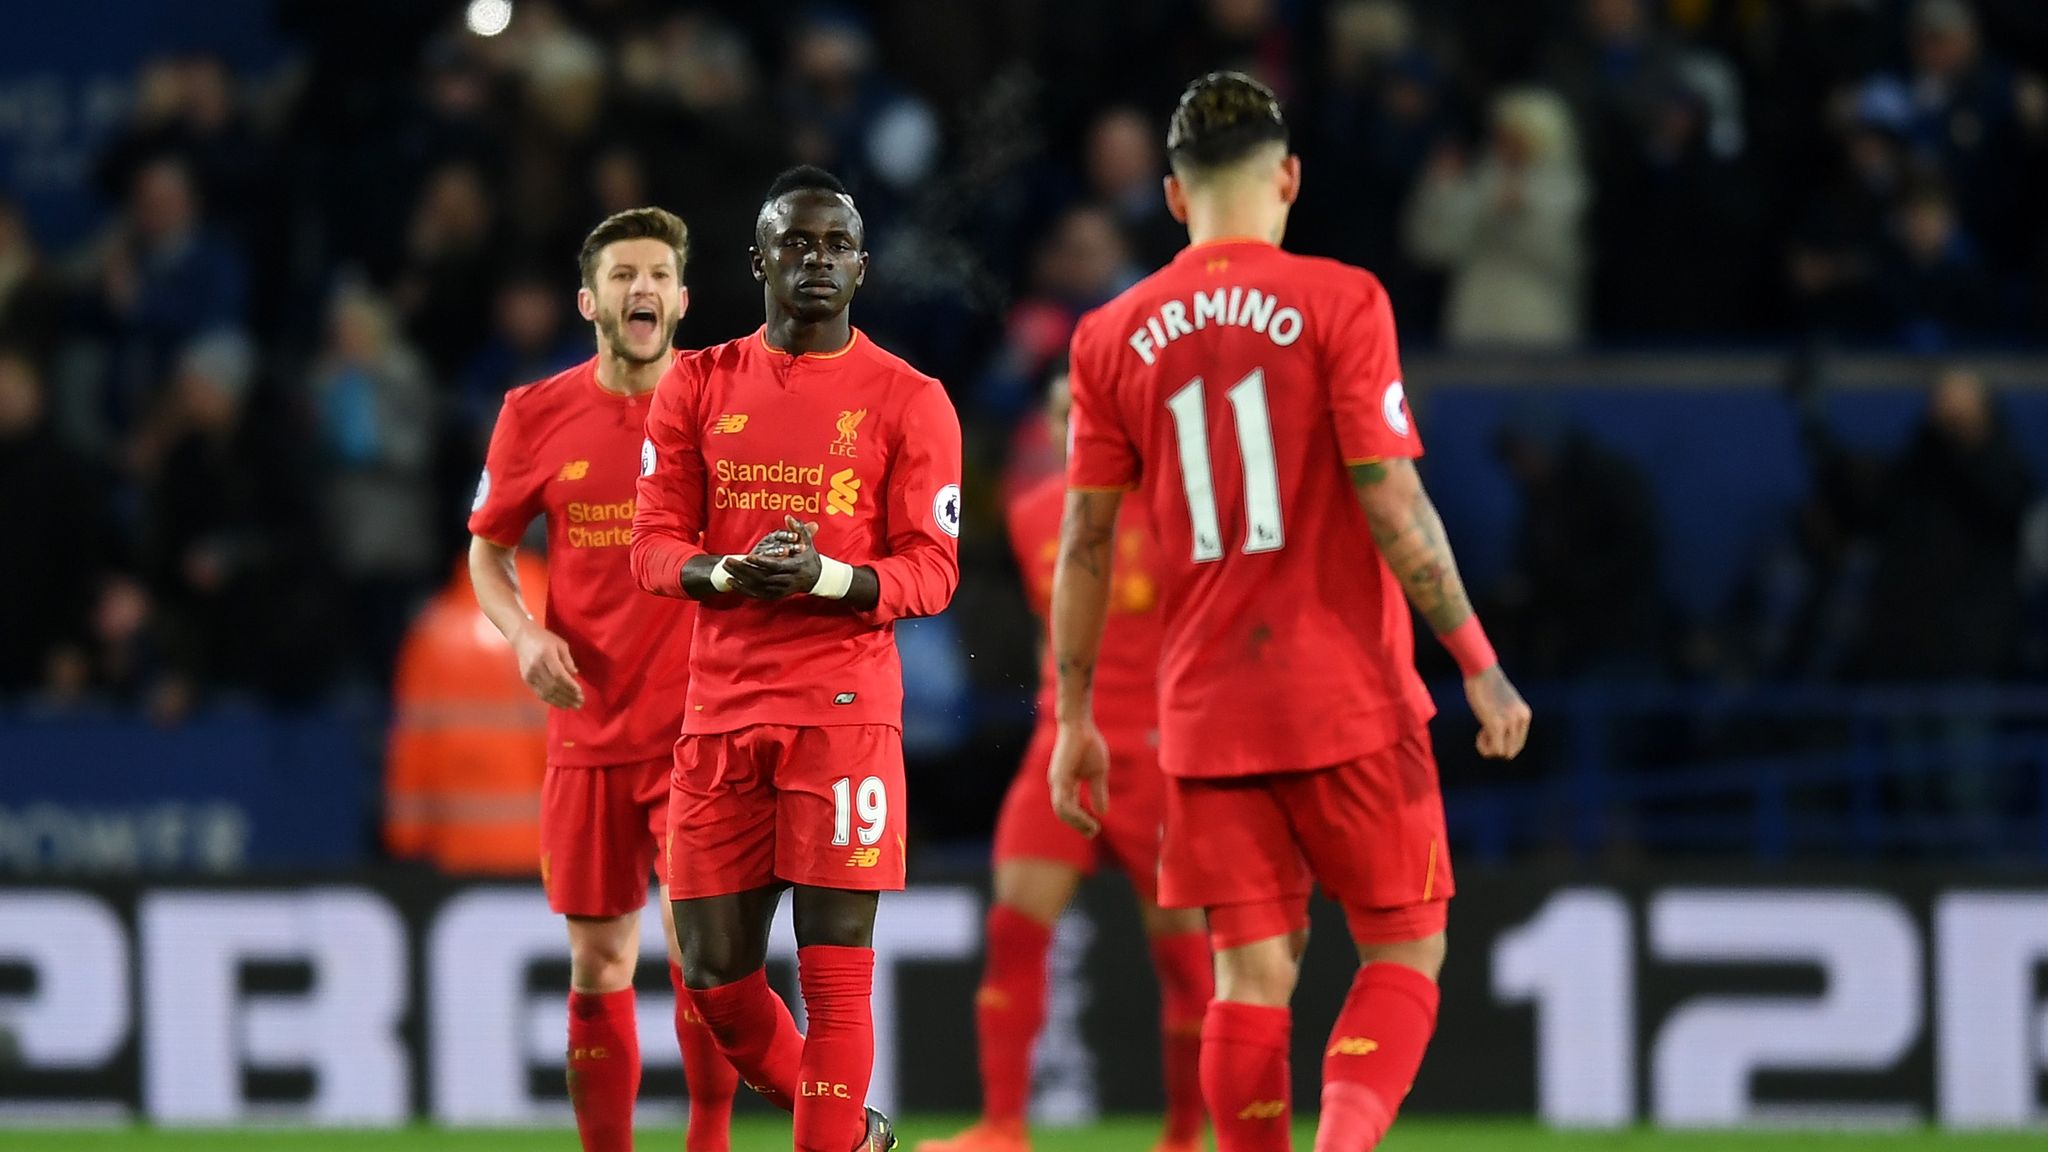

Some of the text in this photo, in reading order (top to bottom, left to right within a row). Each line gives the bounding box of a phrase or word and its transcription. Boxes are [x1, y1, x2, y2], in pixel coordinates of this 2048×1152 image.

[1128, 286, 1304, 366] FIRMINO
[716, 459, 824, 486] Standard
[1164, 366, 1286, 563] 11
[715, 486, 820, 514] Chartered
[831, 776, 888, 846] 19
[801, 1081, 851, 1099] L.F.C.
